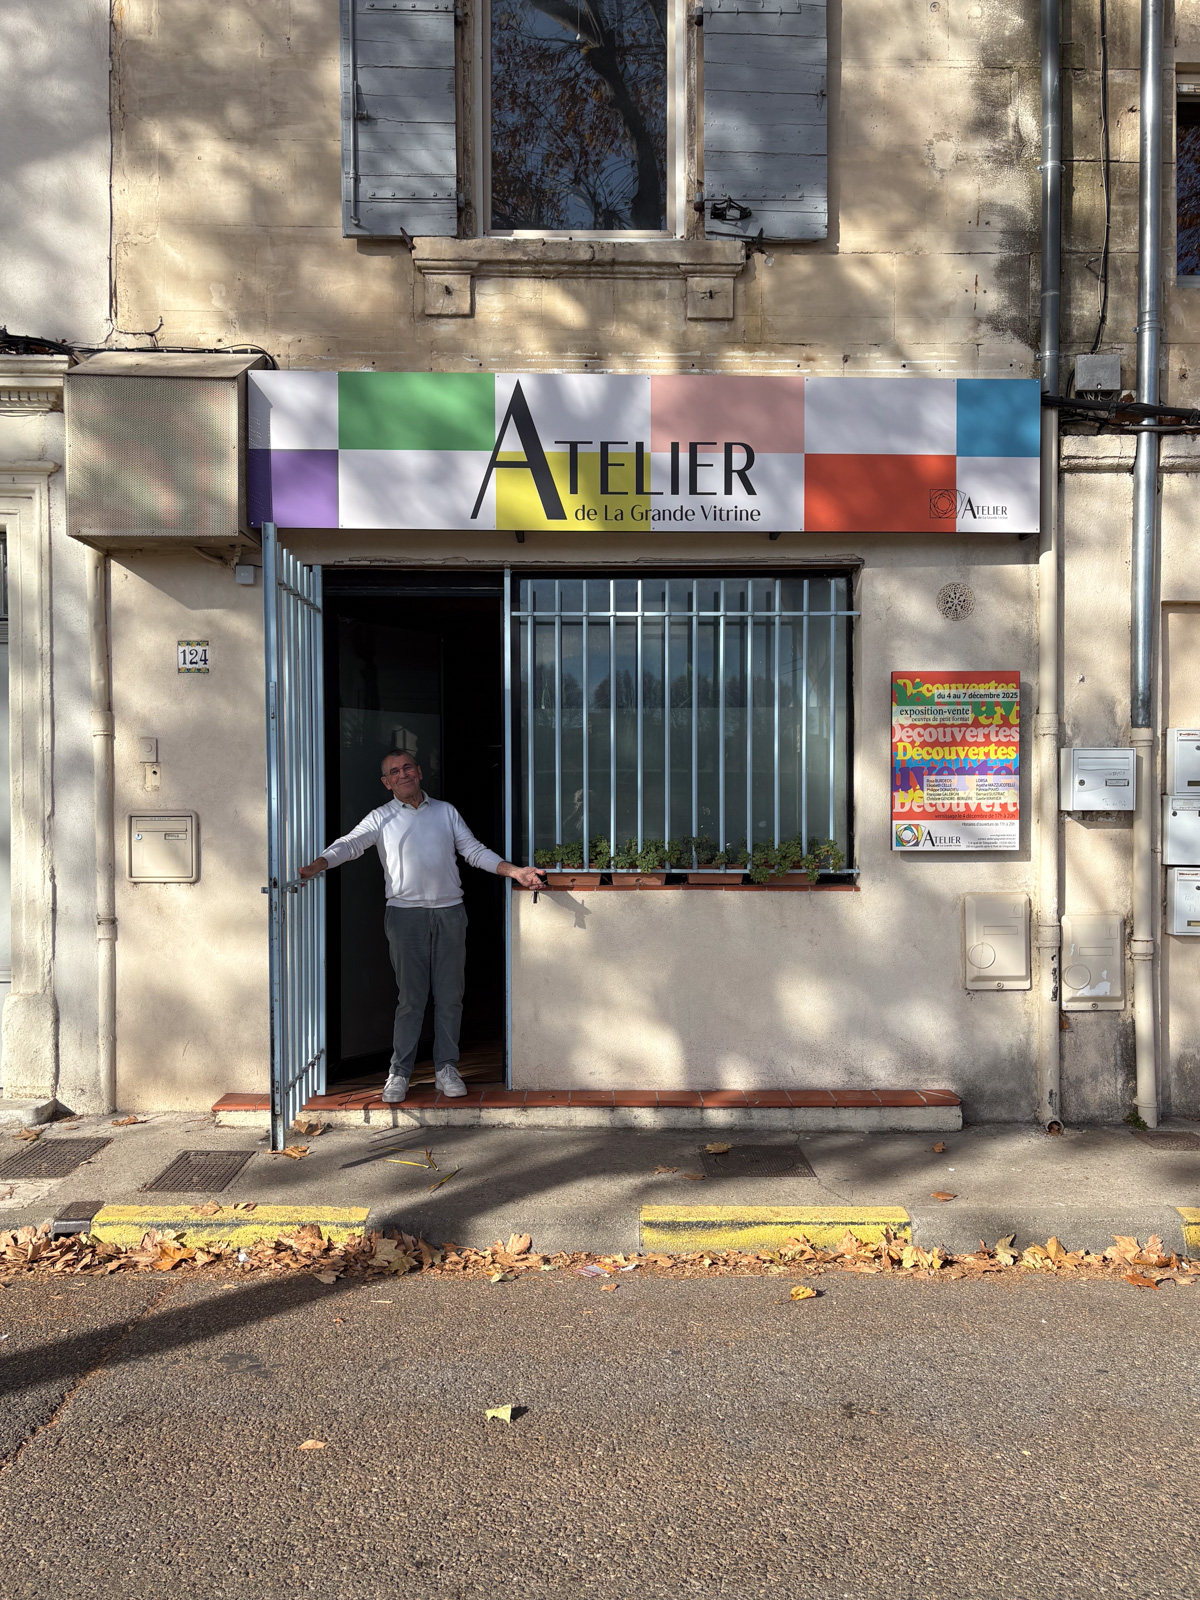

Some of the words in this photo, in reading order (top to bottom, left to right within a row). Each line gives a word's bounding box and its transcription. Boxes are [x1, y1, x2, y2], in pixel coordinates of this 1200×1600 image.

[470, 379, 757, 520] ATELIER
[575, 504, 598, 521] de
[604, 504, 624, 521] La
[630, 504, 696, 522] Grande
[700, 504, 761, 522] Vitrine
[961, 496, 1008, 519] ATELIER
[180, 648, 209, 666] 124
[968, 691, 1000, 699] décembre
[899, 706, 970, 718] exposition-vente
[896, 741, 1017, 760] Découvertes
[921, 829, 962, 847] ATELIER
